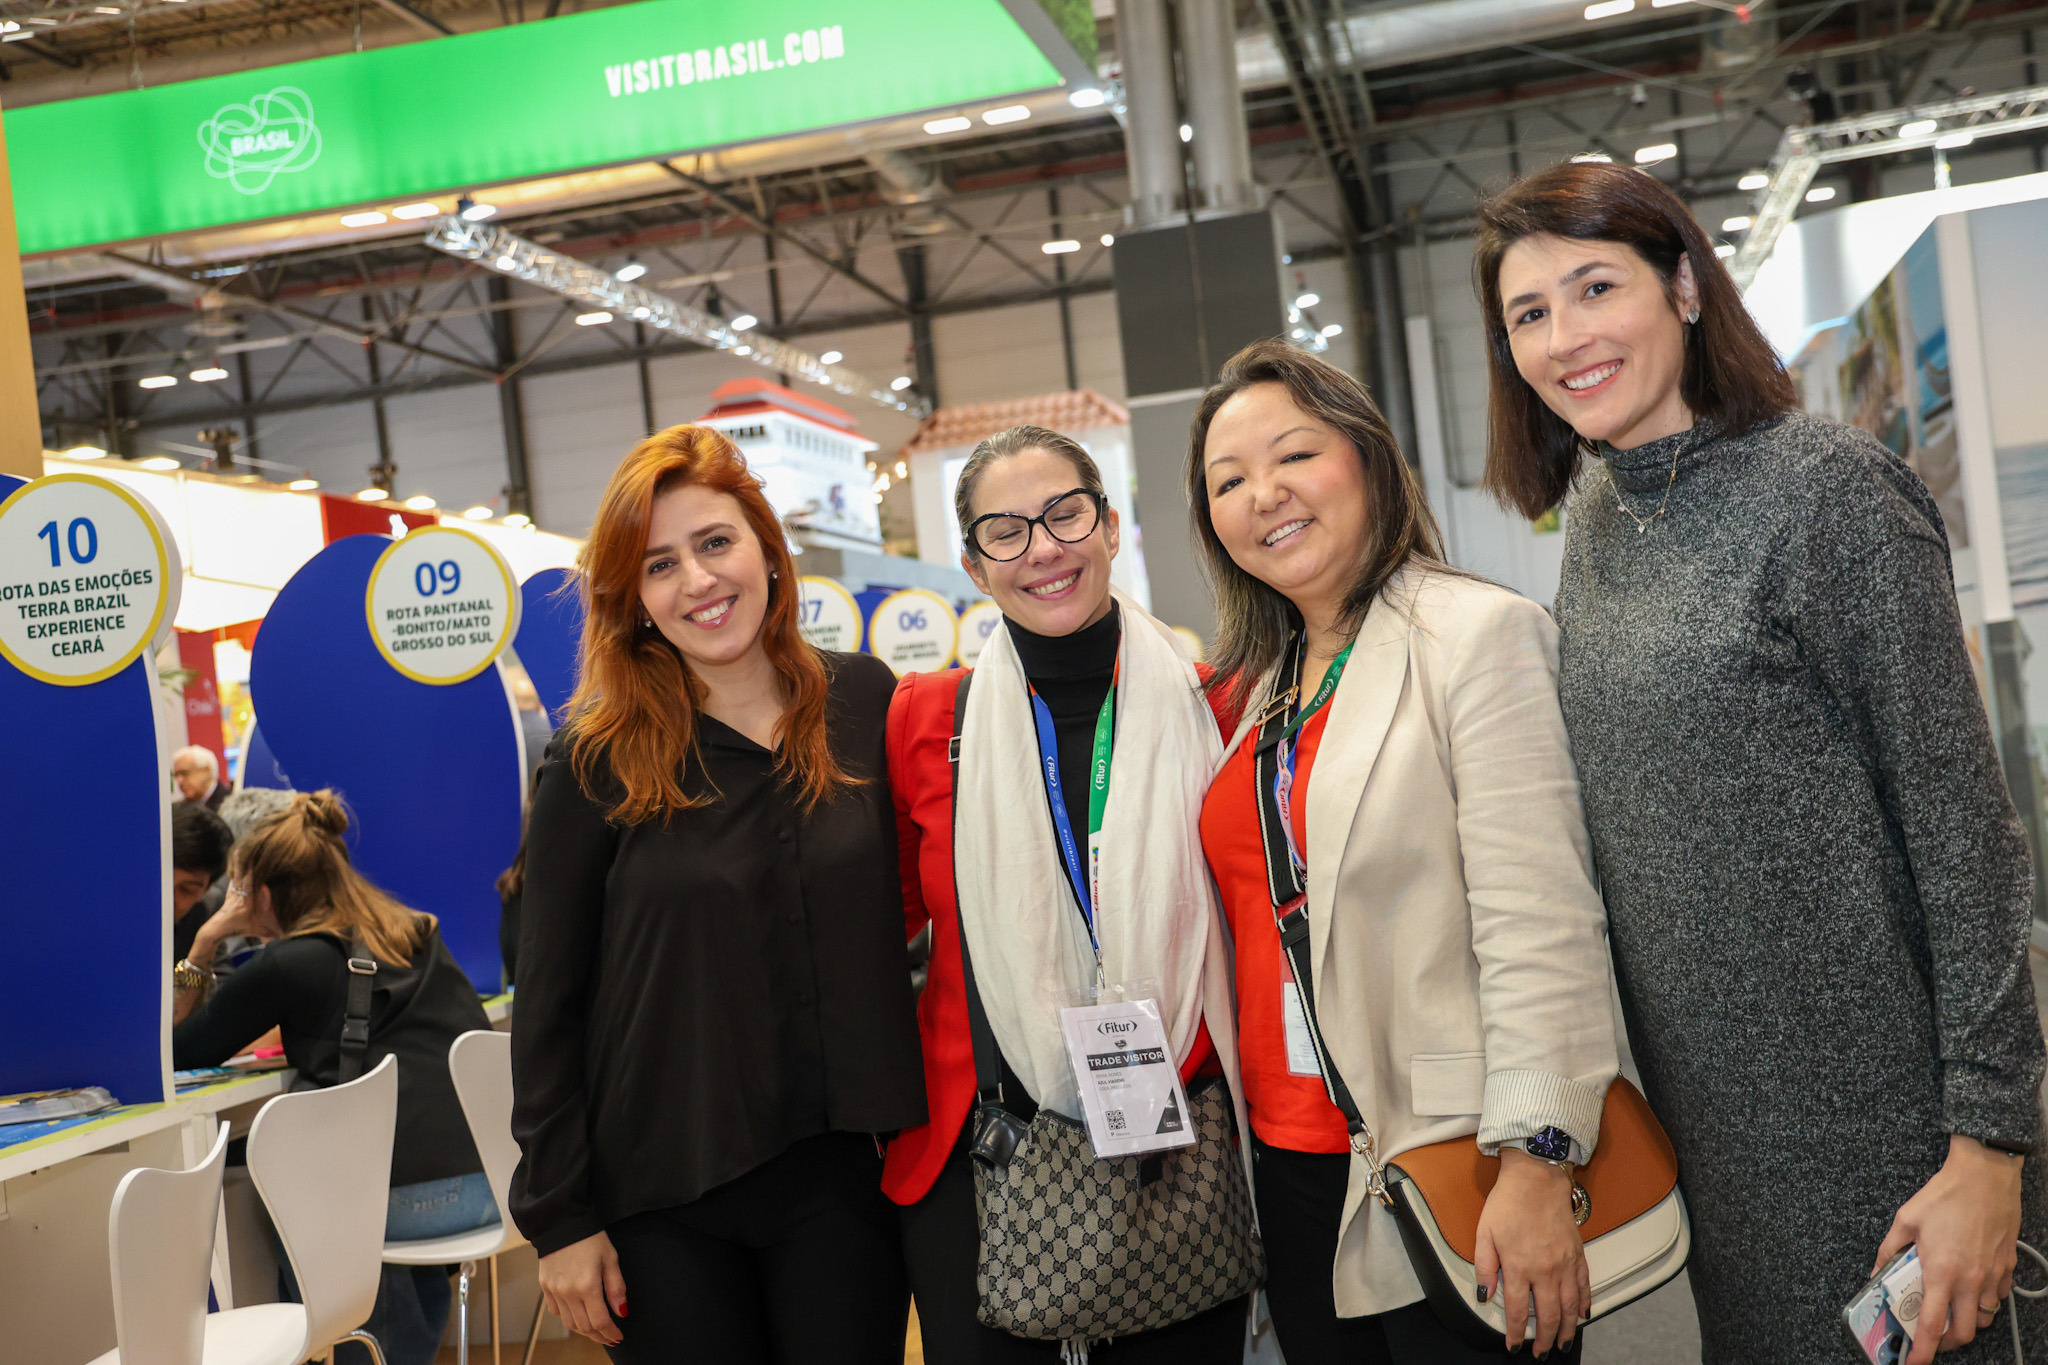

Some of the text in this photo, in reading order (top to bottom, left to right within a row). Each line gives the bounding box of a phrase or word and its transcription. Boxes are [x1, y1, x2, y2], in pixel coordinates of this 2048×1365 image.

[604, 25, 845, 98] VISITBRASIL.COM
[230, 129, 295, 157] BRASIL
[37, 517, 98, 567] 10
[0, 568, 153, 602] OTA DAS EMOÇÕES
[414, 560, 461, 597] 09
[18, 593, 130, 619] TERRA BRAZIL
[386, 599, 494, 622] ROTA PANTANAL
[27, 615, 126, 640] EXPERIENCE
[898, 609, 928, 632] 06
[51, 635, 105, 657] CEARÁ
[392, 632, 494, 652] GROSSO DO SUL
[1088, 1051, 1163, 1067] TRADE VISITOR
